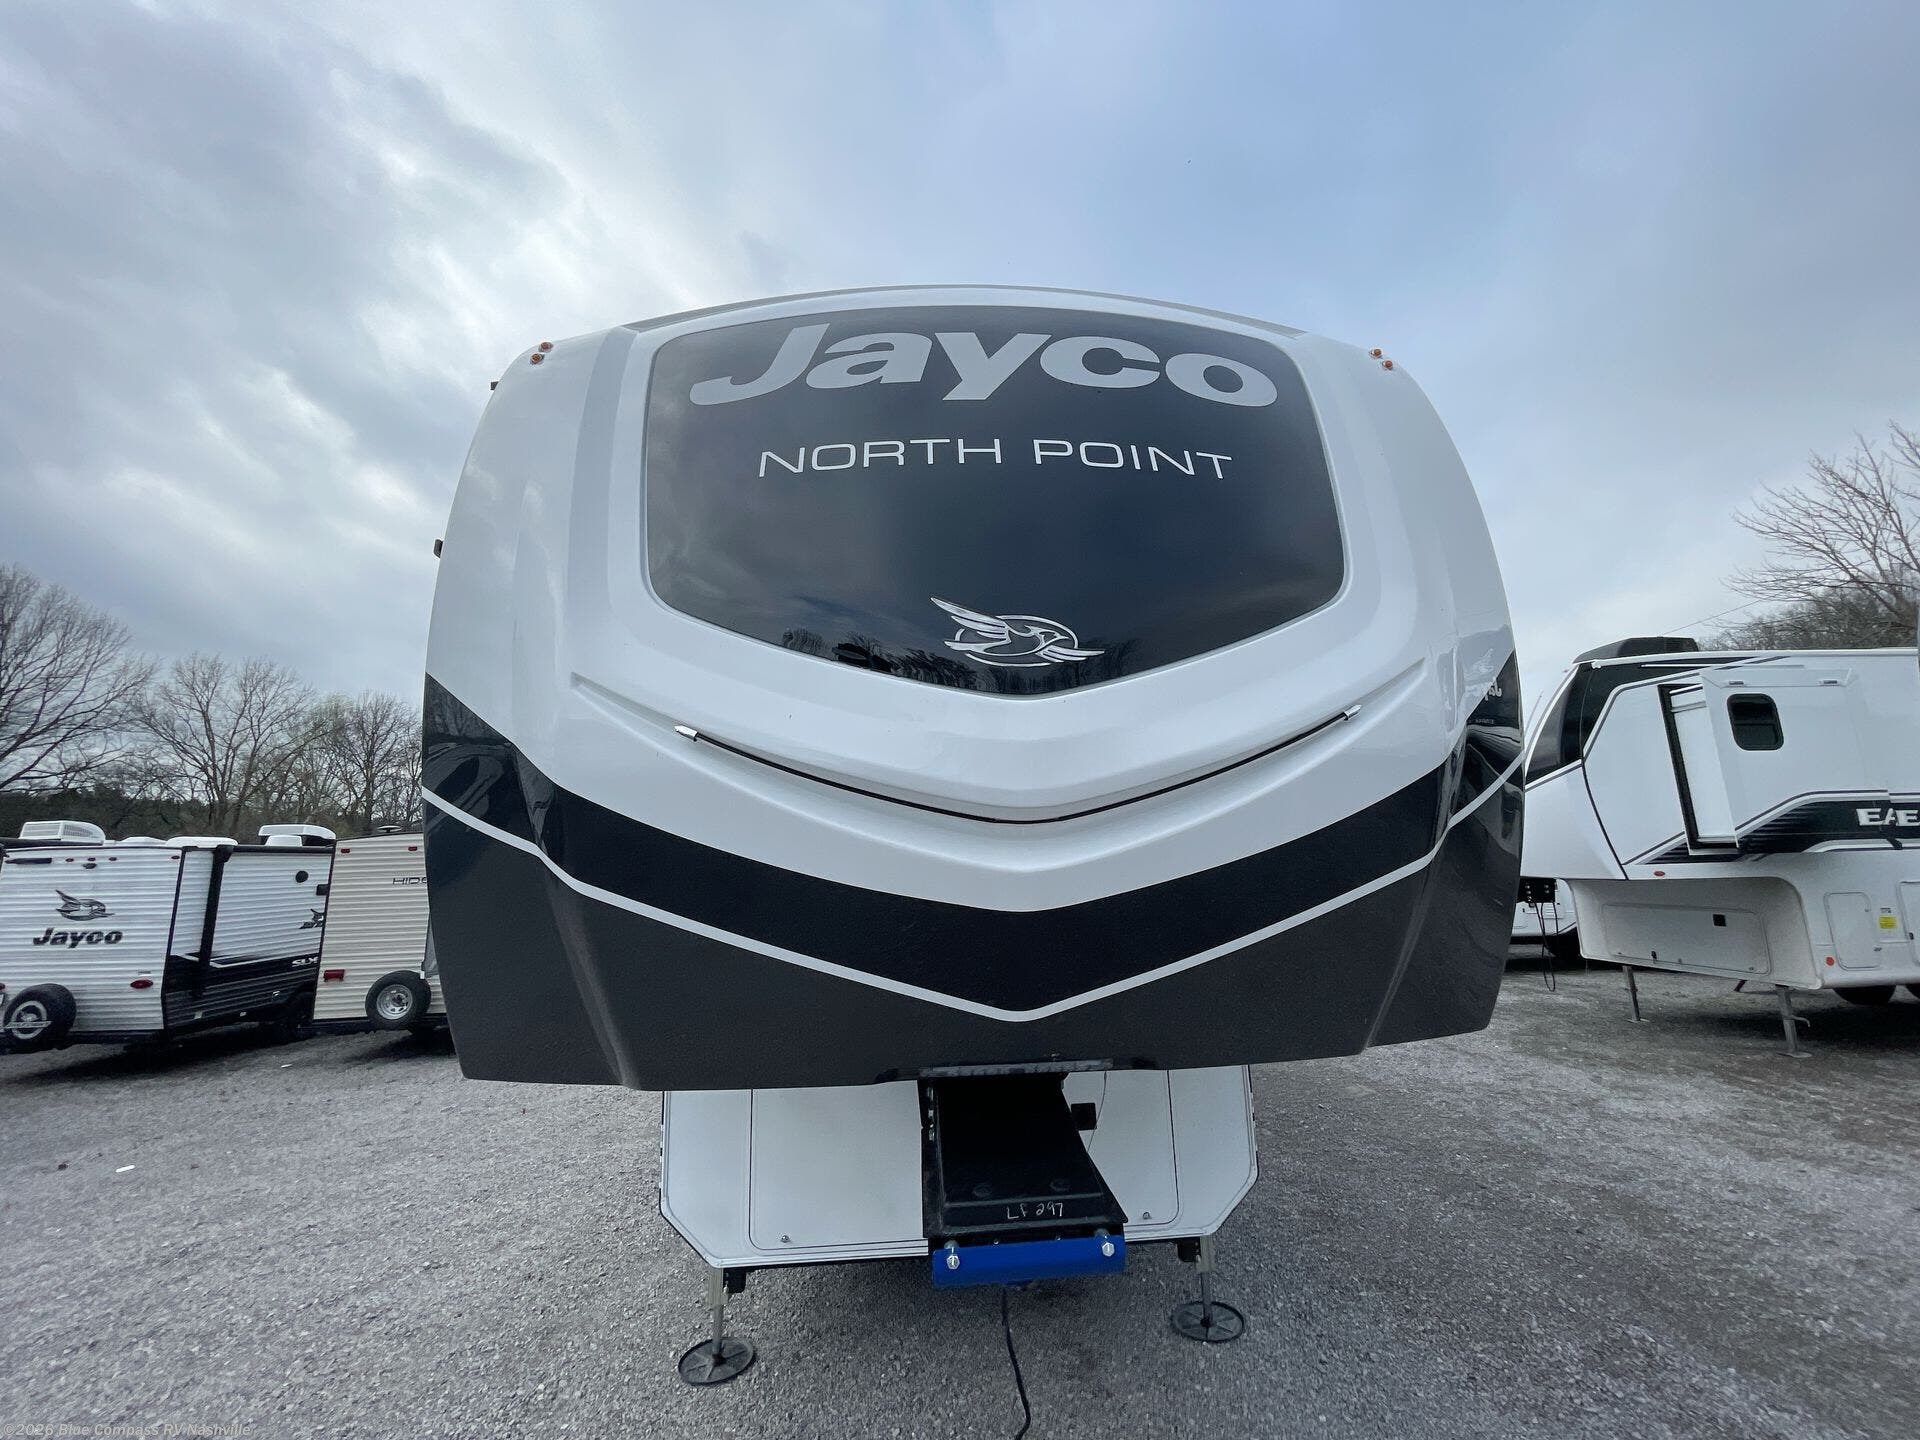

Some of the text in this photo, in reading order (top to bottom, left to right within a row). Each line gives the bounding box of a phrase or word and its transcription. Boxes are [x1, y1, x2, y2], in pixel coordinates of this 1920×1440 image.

[690, 324, 1277, 406] Jayco
[759, 438, 1232, 479] NORTH POINT
[33, 927, 123, 949] Jayco
[1035, 1201, 1063, 1217] 297
